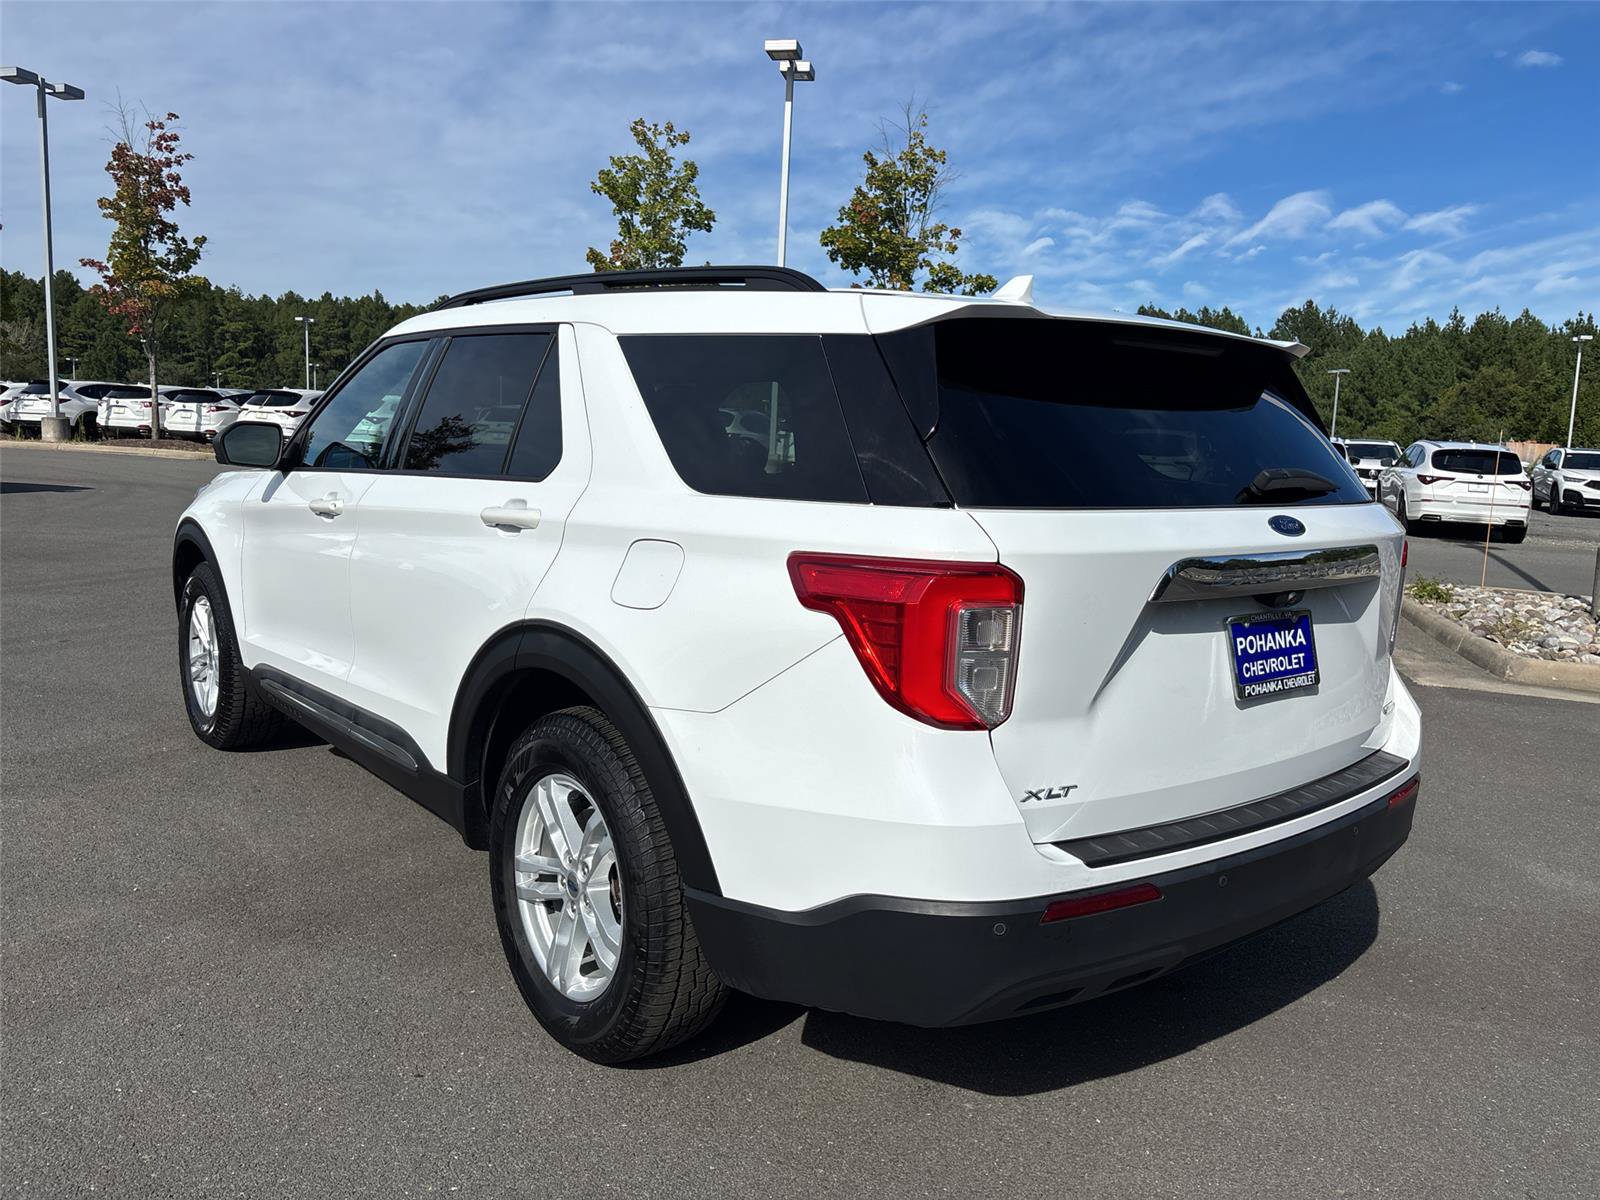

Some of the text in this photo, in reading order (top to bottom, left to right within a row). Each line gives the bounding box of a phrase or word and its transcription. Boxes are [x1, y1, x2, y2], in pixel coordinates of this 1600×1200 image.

[1236, 628, 1306, 656] POHANKA
[1243, 653, 1305, 678] CHEVROLET
[1245, 674, 1316, 697] POHANKA CHEVROLET
[1020, 785, 1078, 802] XLT
